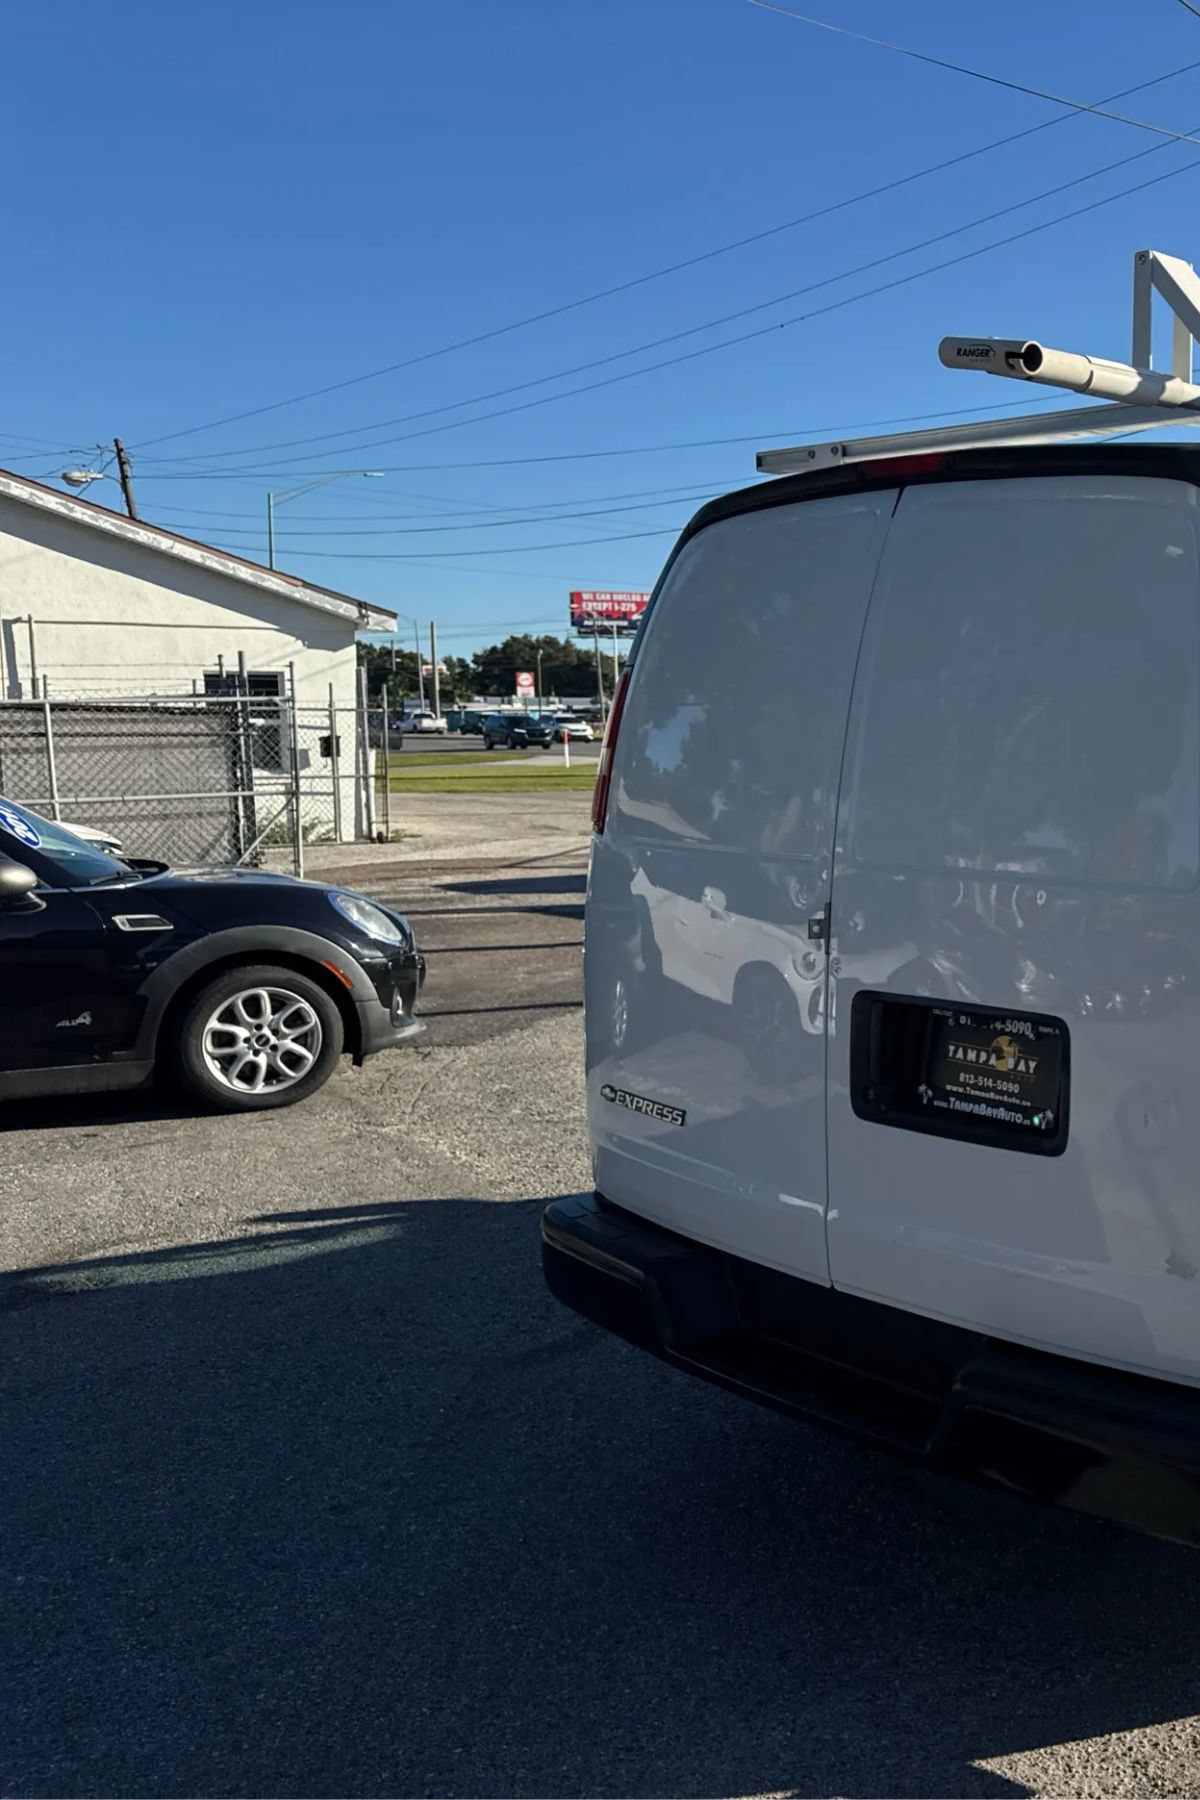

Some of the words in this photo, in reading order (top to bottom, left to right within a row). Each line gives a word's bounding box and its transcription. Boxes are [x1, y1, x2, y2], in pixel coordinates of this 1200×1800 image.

[956, 347, 990, 358] RANGER
[582, 601, 614, 611] EXCEPT
[614, 602, 637, 612] I-275
[948, 1045, 997, 1066] TAMPA
[1007, 1057, 1038, 1074] BAY
[959, 1072, 1020, 1095] 813-514-5090
[615, 1091, 682, 1125] EXPRESS
